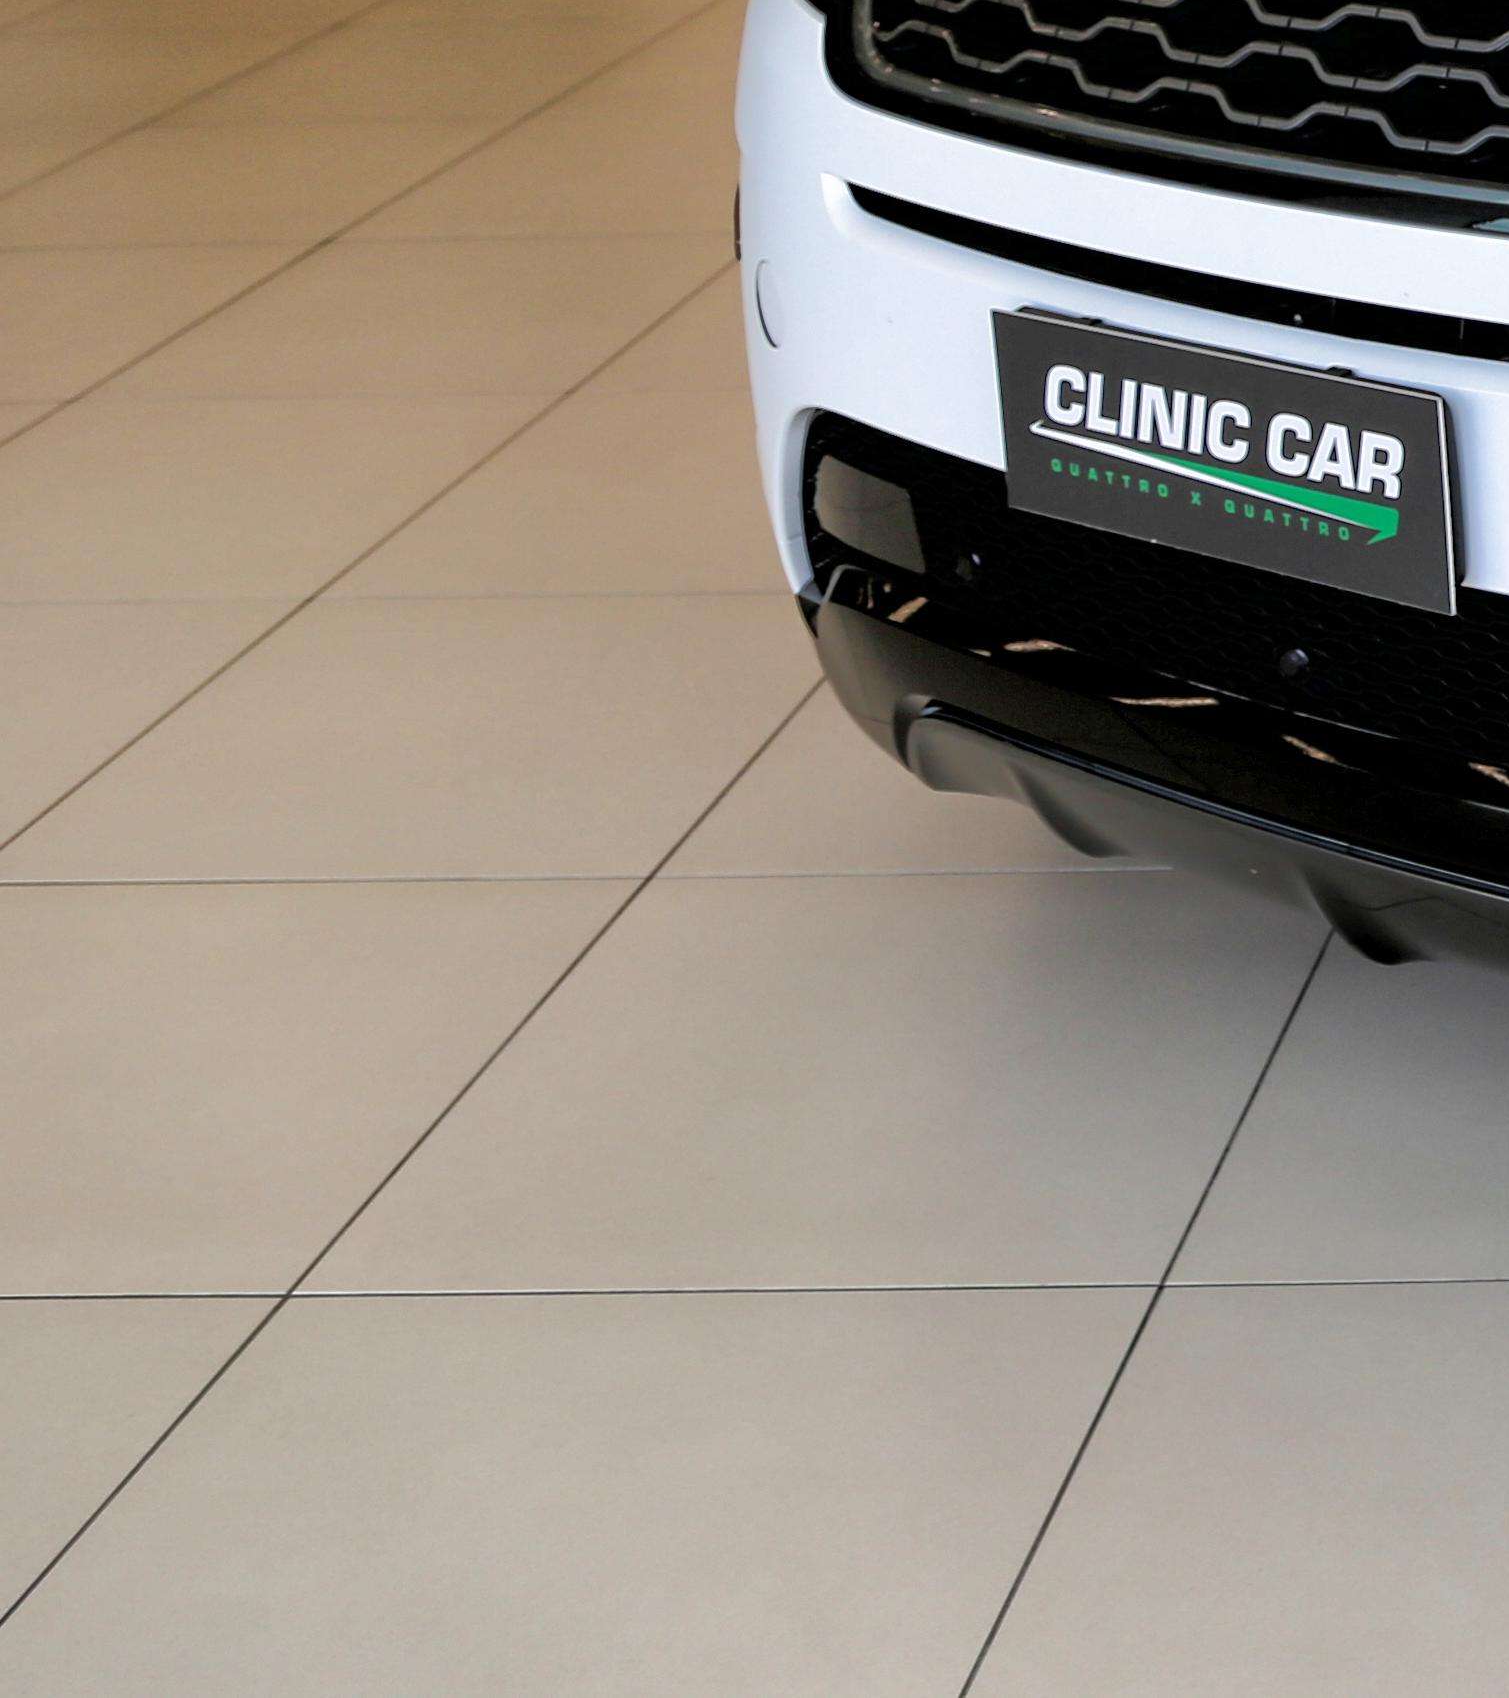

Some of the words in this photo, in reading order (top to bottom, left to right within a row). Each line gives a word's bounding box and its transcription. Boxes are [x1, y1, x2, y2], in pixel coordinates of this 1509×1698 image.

[1043, 363, 1253, 464] CLINIC
[1265, 411, 1405, 501] CAR
[1050, 457, 1169, 499] QUATTRO
[1224, 498, 1350, 542] QUATTRO
